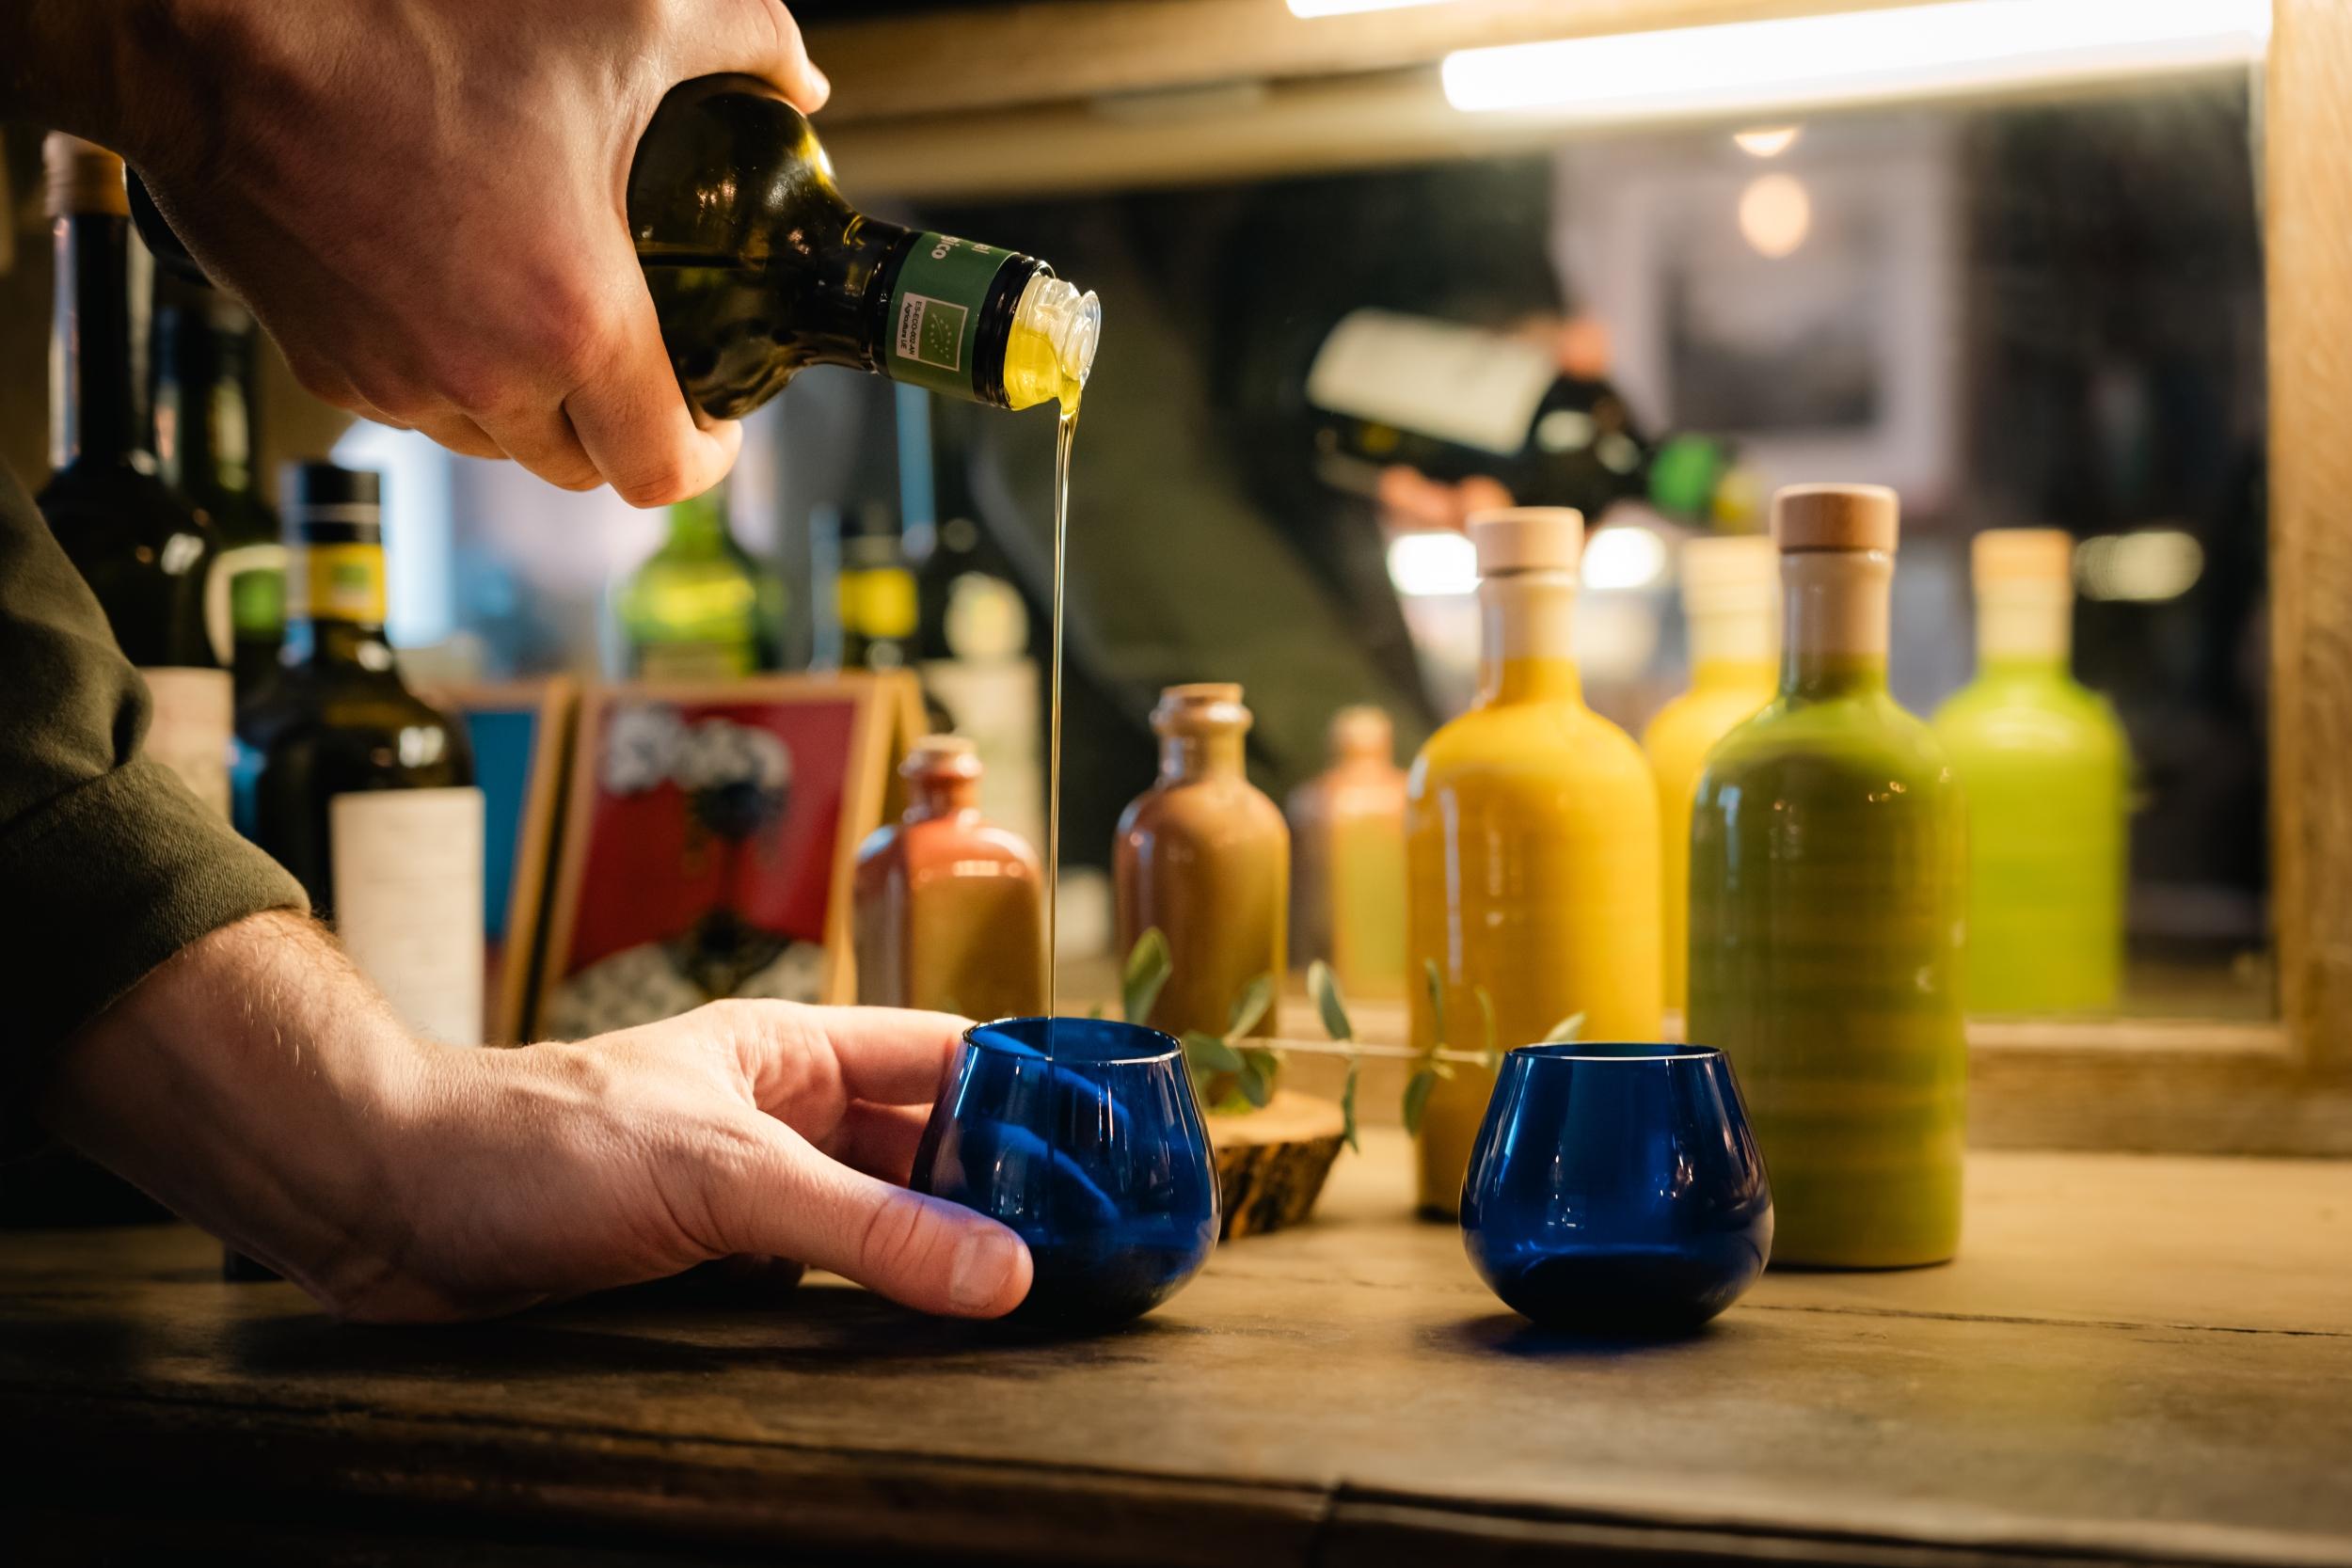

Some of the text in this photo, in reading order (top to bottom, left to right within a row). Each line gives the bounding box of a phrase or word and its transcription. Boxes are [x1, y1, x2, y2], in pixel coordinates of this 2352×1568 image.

[900, 303, 913, 349] Agricultura UE
[909, 301, 923, 356] ES-ECO-002-AN
